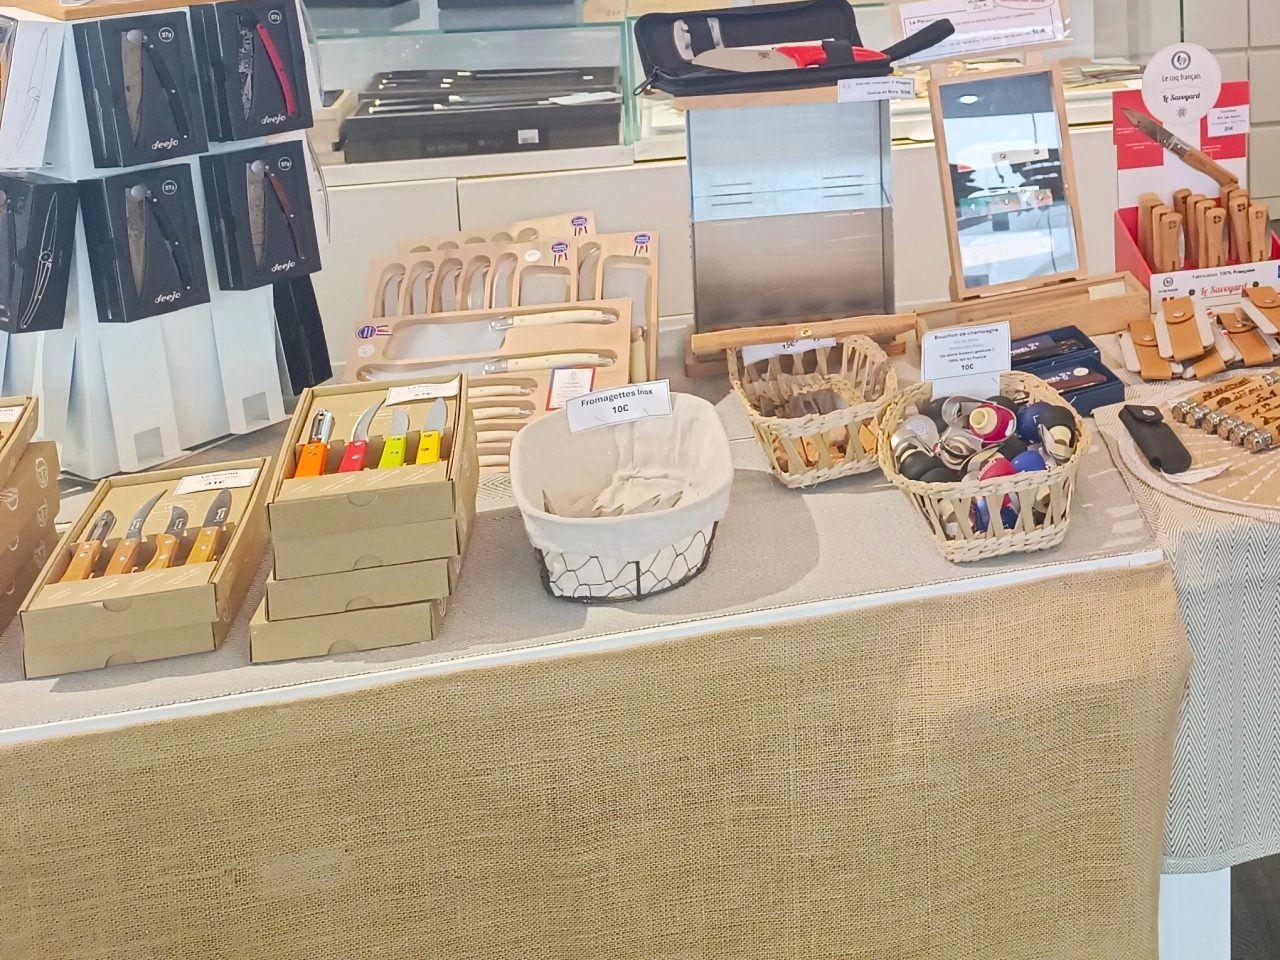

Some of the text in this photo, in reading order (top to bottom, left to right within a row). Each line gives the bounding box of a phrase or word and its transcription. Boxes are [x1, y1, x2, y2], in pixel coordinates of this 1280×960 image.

[1170, 92, 1201, 102] Savoyard
[261, 113, 286, 125] deejo
[151, 138, 179, 150] deejo
[271, 260, 296, 272] deejo
[154, 291, 181, 304] deejo
[961, 363, 974, 371] 10€
[581, 389, 636, 407] Fromagettes
[637, 388, 654, 396] Inox
[612, 405, 629, 414] 10€
